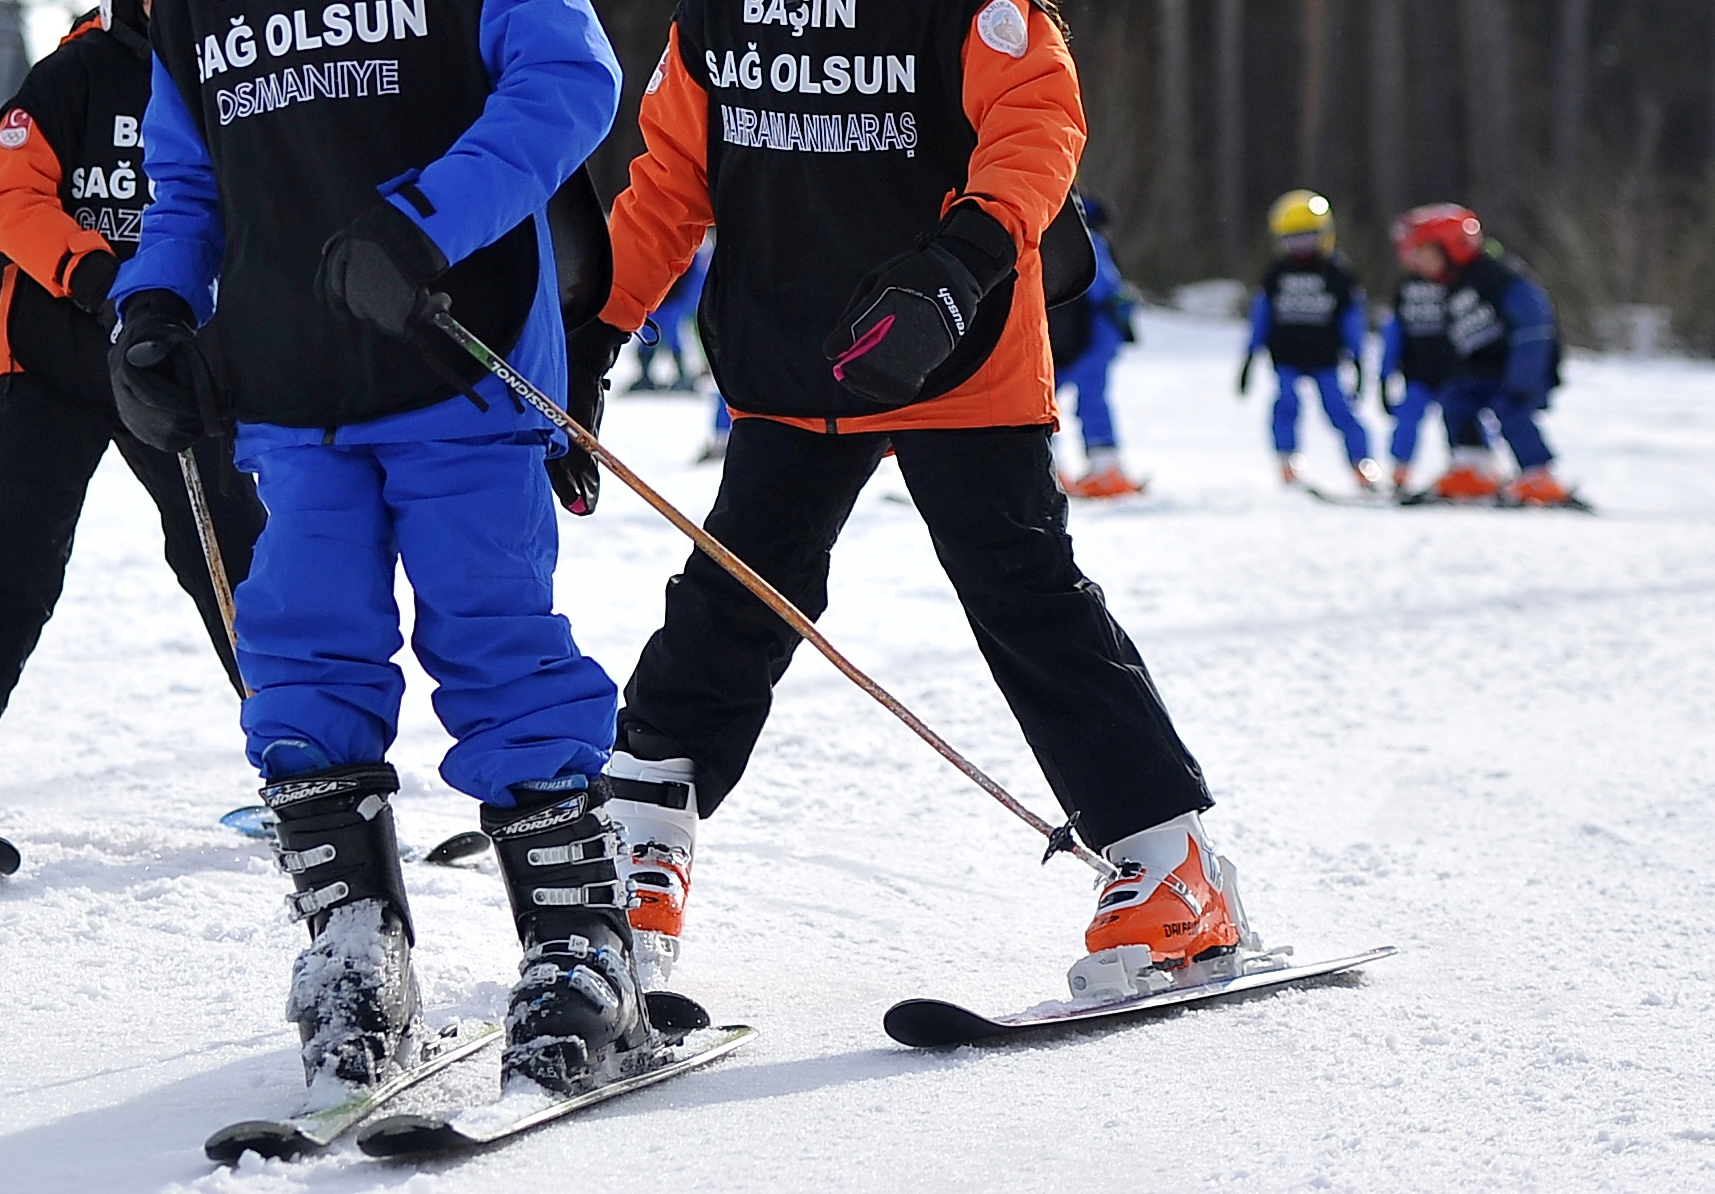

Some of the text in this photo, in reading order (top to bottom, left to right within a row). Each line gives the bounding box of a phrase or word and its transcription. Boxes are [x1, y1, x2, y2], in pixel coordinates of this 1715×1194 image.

[705, 42, 916, 95] SAĞ OLSUN
[113, 114, 145, 148] B
[71, 160, 137, 200] SAĞ
[490, 361, 568, 427] ROSSIGNOL
[270, 781, 338, 806] NORDICA
[502, 807, 580, 835] NORDICA
